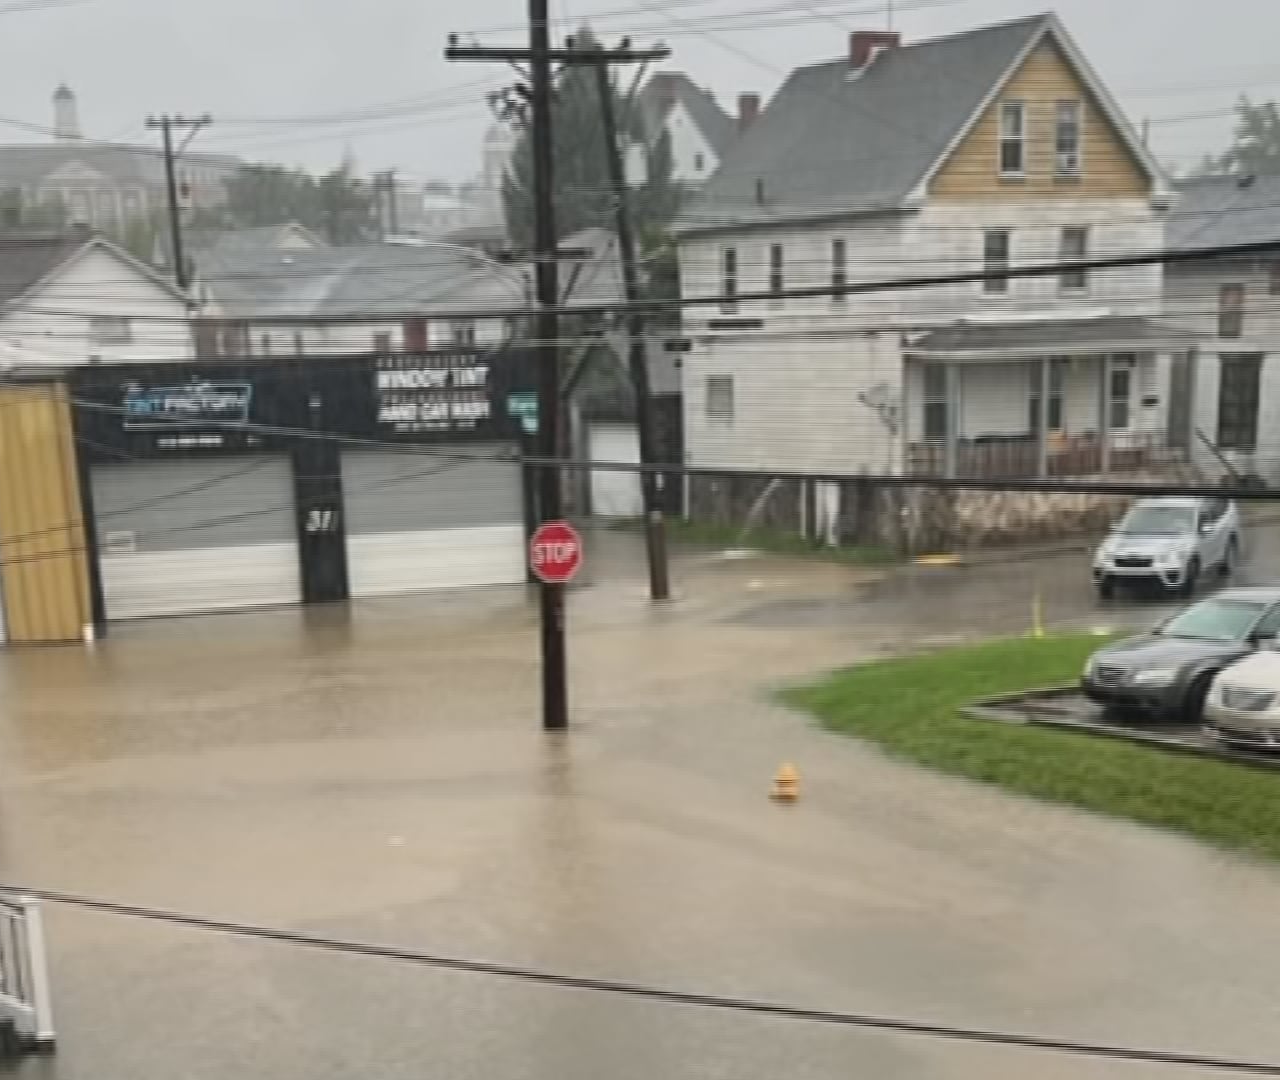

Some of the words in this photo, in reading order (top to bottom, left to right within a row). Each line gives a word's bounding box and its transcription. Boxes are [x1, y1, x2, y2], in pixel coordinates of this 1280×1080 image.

[452, 366, 488, 387] TINT
[421, 403, 449, 421] CAR
[533, 541, 577, 566] STOP
